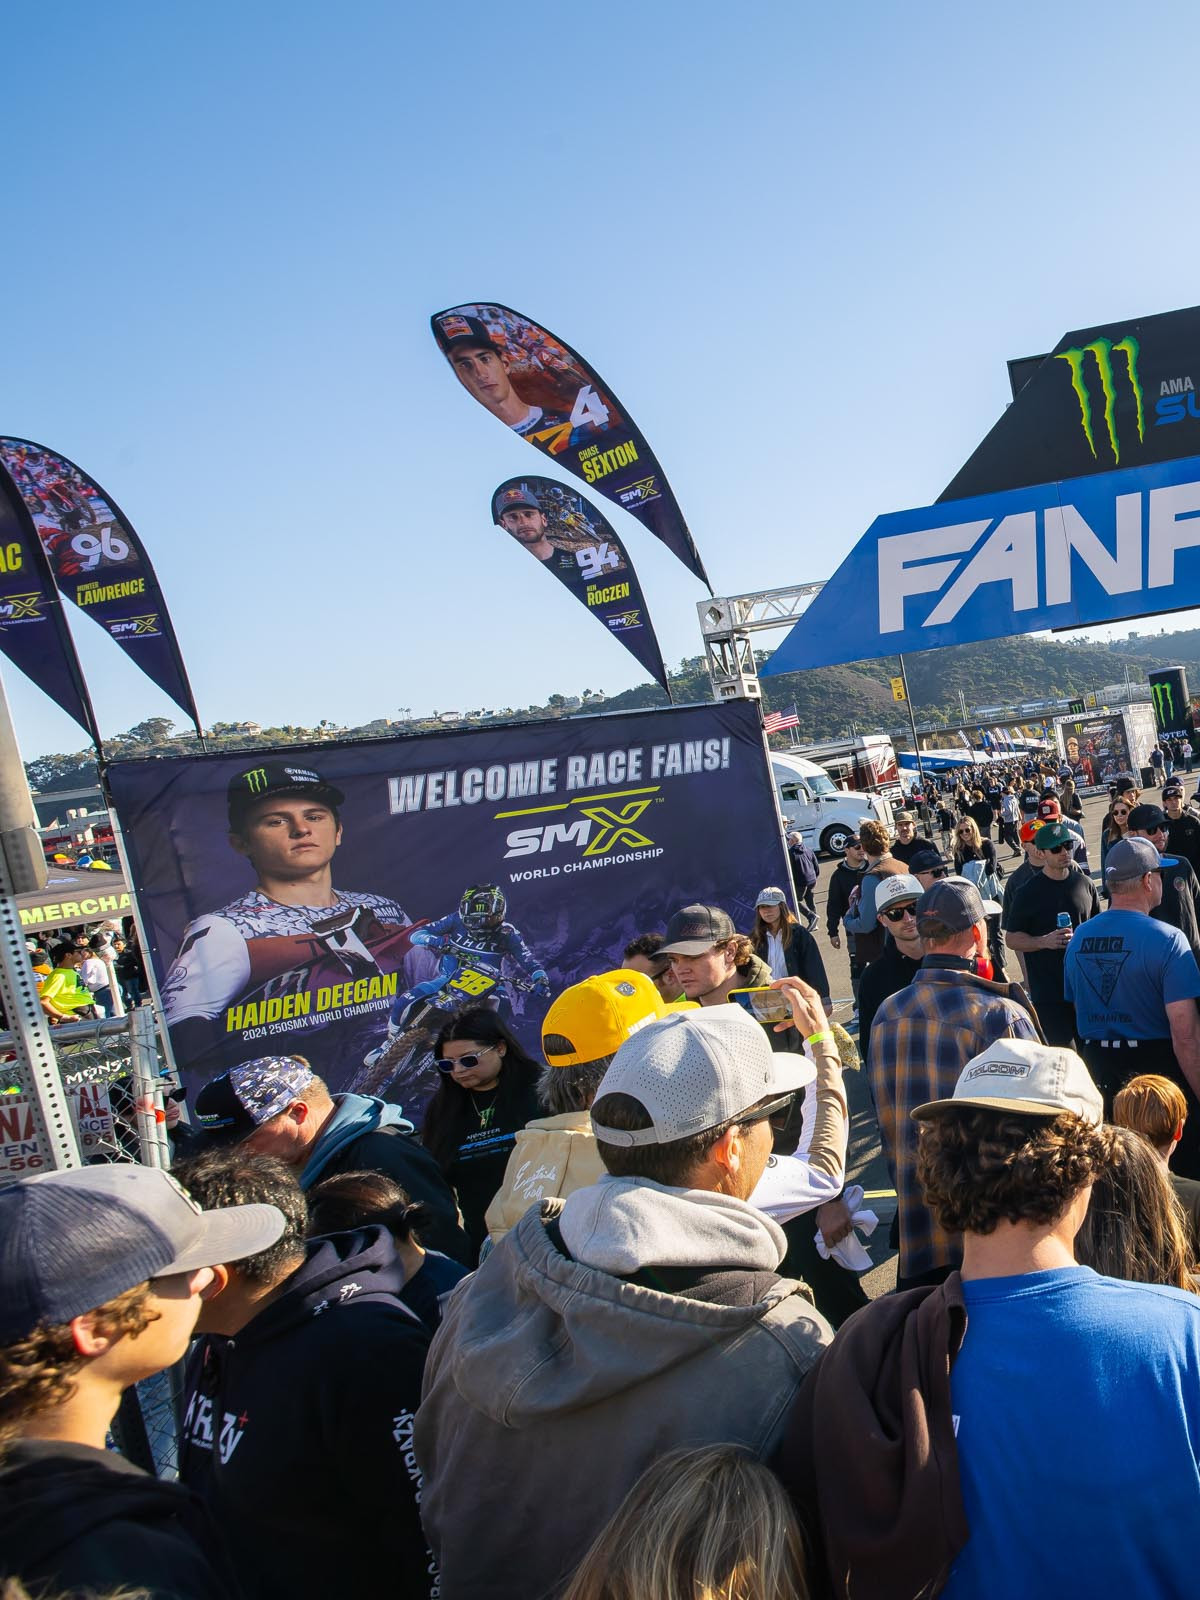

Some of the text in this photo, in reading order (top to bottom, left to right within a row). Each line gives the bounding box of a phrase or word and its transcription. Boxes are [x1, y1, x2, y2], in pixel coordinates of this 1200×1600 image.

[1160, 376, 1195, 396] AMA
[570, 384, 609, 427] 4
[578, 445, 600, 462] CHASE
[582, 440, 639, 483] SEXTON
[620, 480, 658, 503] SMX
[0, 543, 22, 573] C
[71, 528, 129, 572] 96
[575, 543, 619, 577] 94
[77, 581, 99, 592] HUNTER
[77, 578, 145, 607] LAWRENCE
[587, 582, 630, 606] ROCZEN
[0, 597, 41, 619] MX
[608, 612, 640, 627] SMX
[110, 618, 159, 634] SMX
[388, 737, 731, 814] WELCOME RACE FANS!
[503, 799, 655, 858] SMX
[510, 848, 664, 883] WORLD CHAMPIONSHIP
[18, 893, 131, 925] MERCHA
[449, 969, 496, 996] 38
[226, 973, 398, 1032] HAIDEN DEEGAN
[242, 1000, 390, 1041] 2024 250SMX WORLD CHAMPION
[65, 1056, 132, 1085] MONST
[969, 1063, 1026, 1079] VOLCOM
